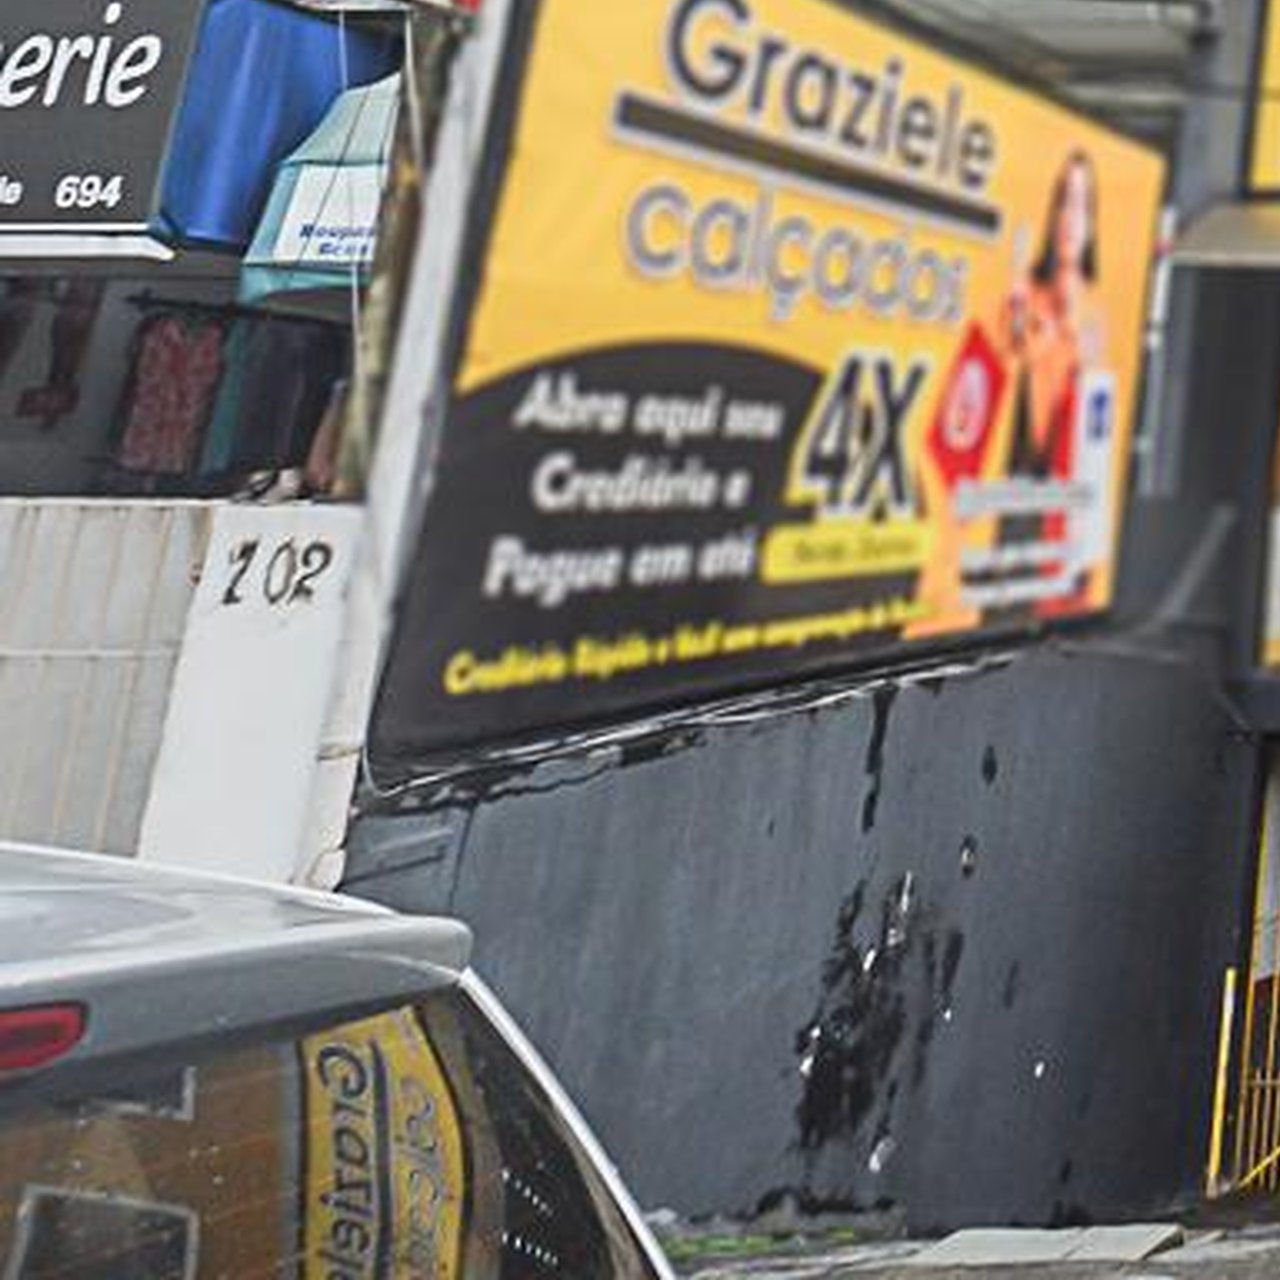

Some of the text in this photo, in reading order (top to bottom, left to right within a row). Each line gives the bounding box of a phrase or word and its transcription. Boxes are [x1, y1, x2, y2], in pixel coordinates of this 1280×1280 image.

[0, 2, 161, 107] erie
[55, 175, 124, 208] 694
[626, 173, 970, 319] calçados
[803, 354, 928, 509] 4X
